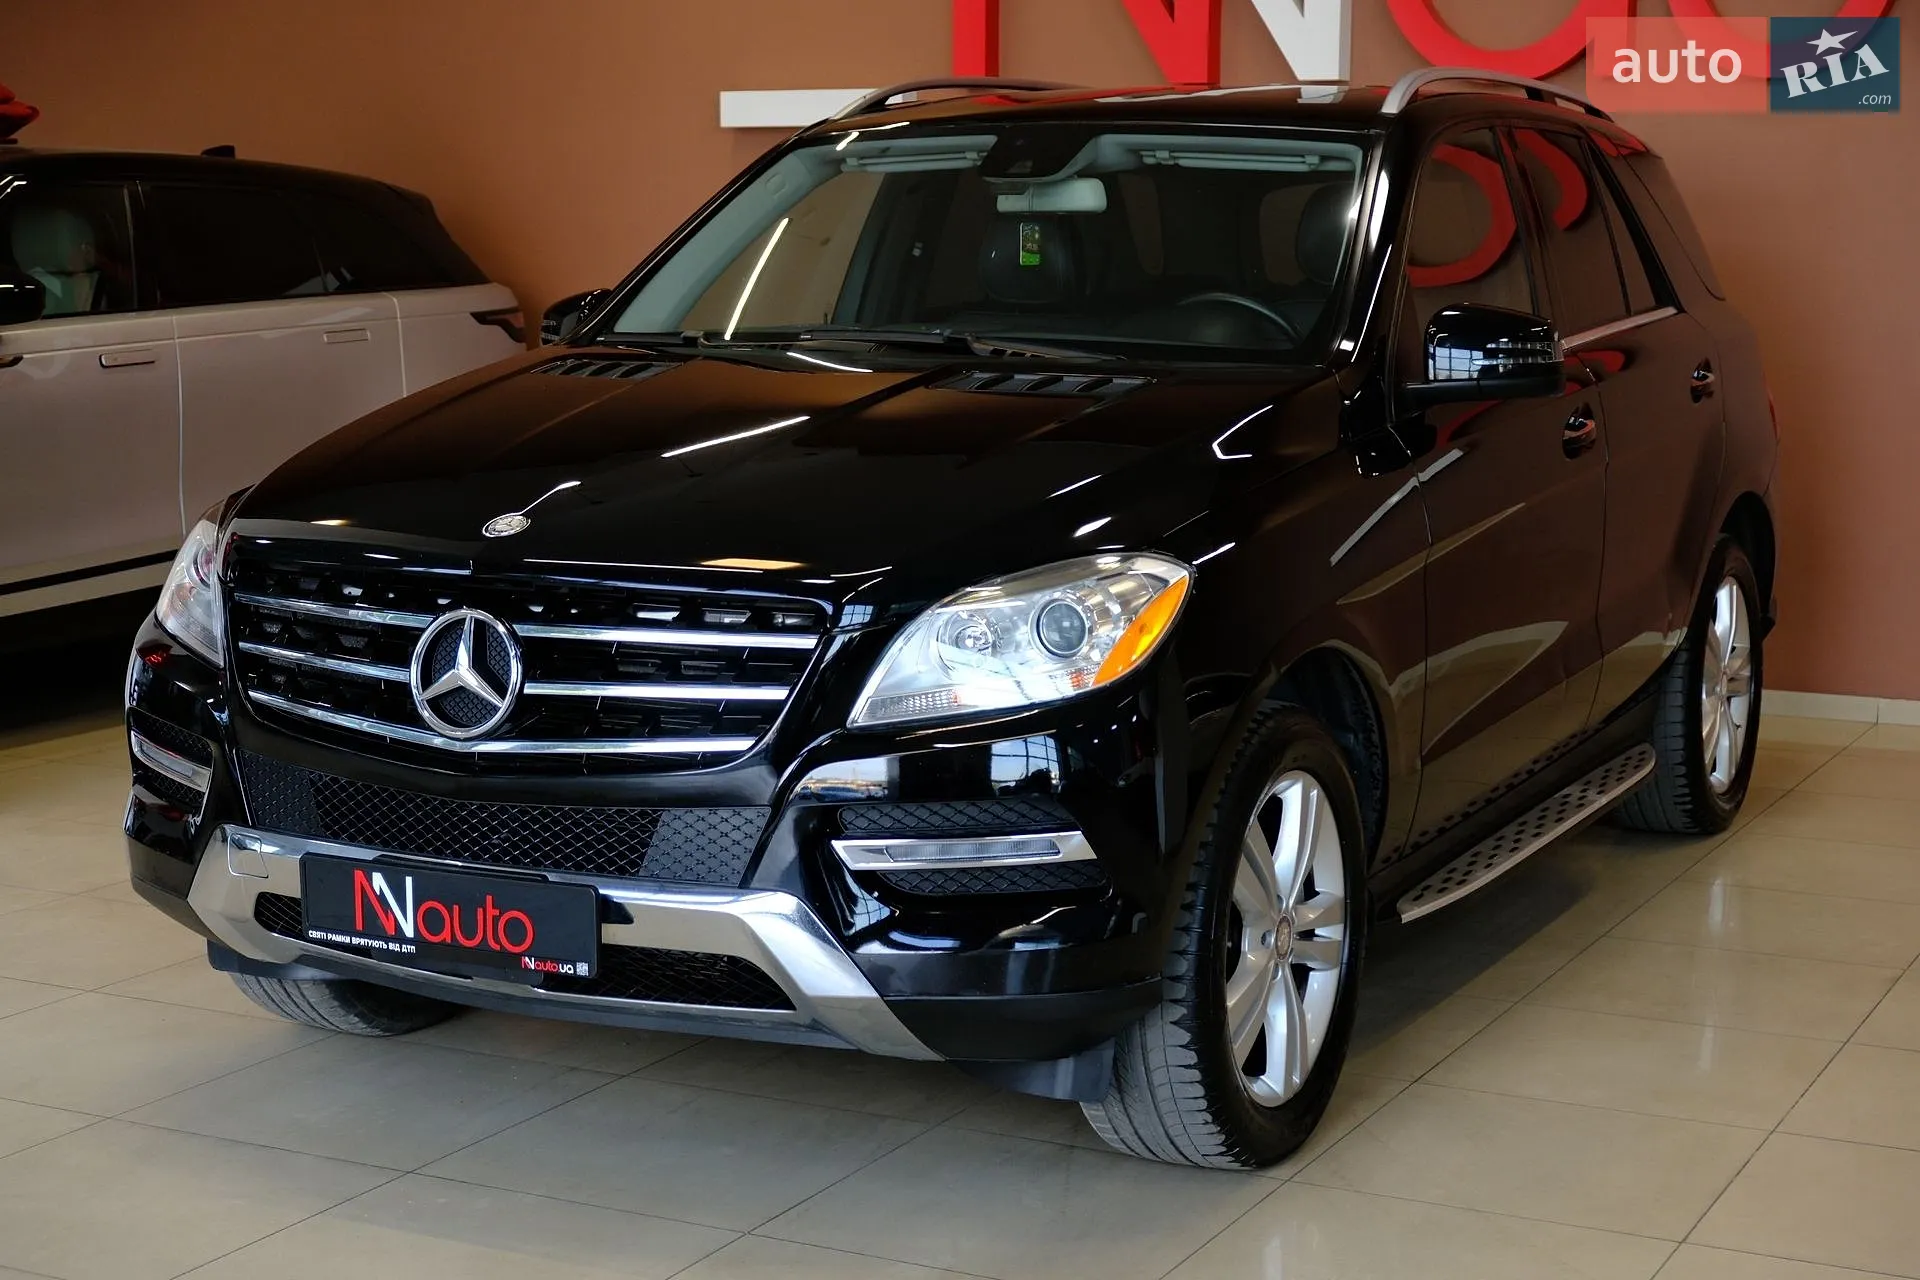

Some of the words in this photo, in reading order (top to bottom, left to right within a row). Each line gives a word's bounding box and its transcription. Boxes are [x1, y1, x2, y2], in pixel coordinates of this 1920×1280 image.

[308, 930, 326, 940] СВЯТІ
[327, 933, 351, 944] РАМКИ
[352, 936, 387, 949] ВРЯТУЮТЬ
[388, 942, 400, 953] ВІД
[401, 944, 416, 954] ДТП
